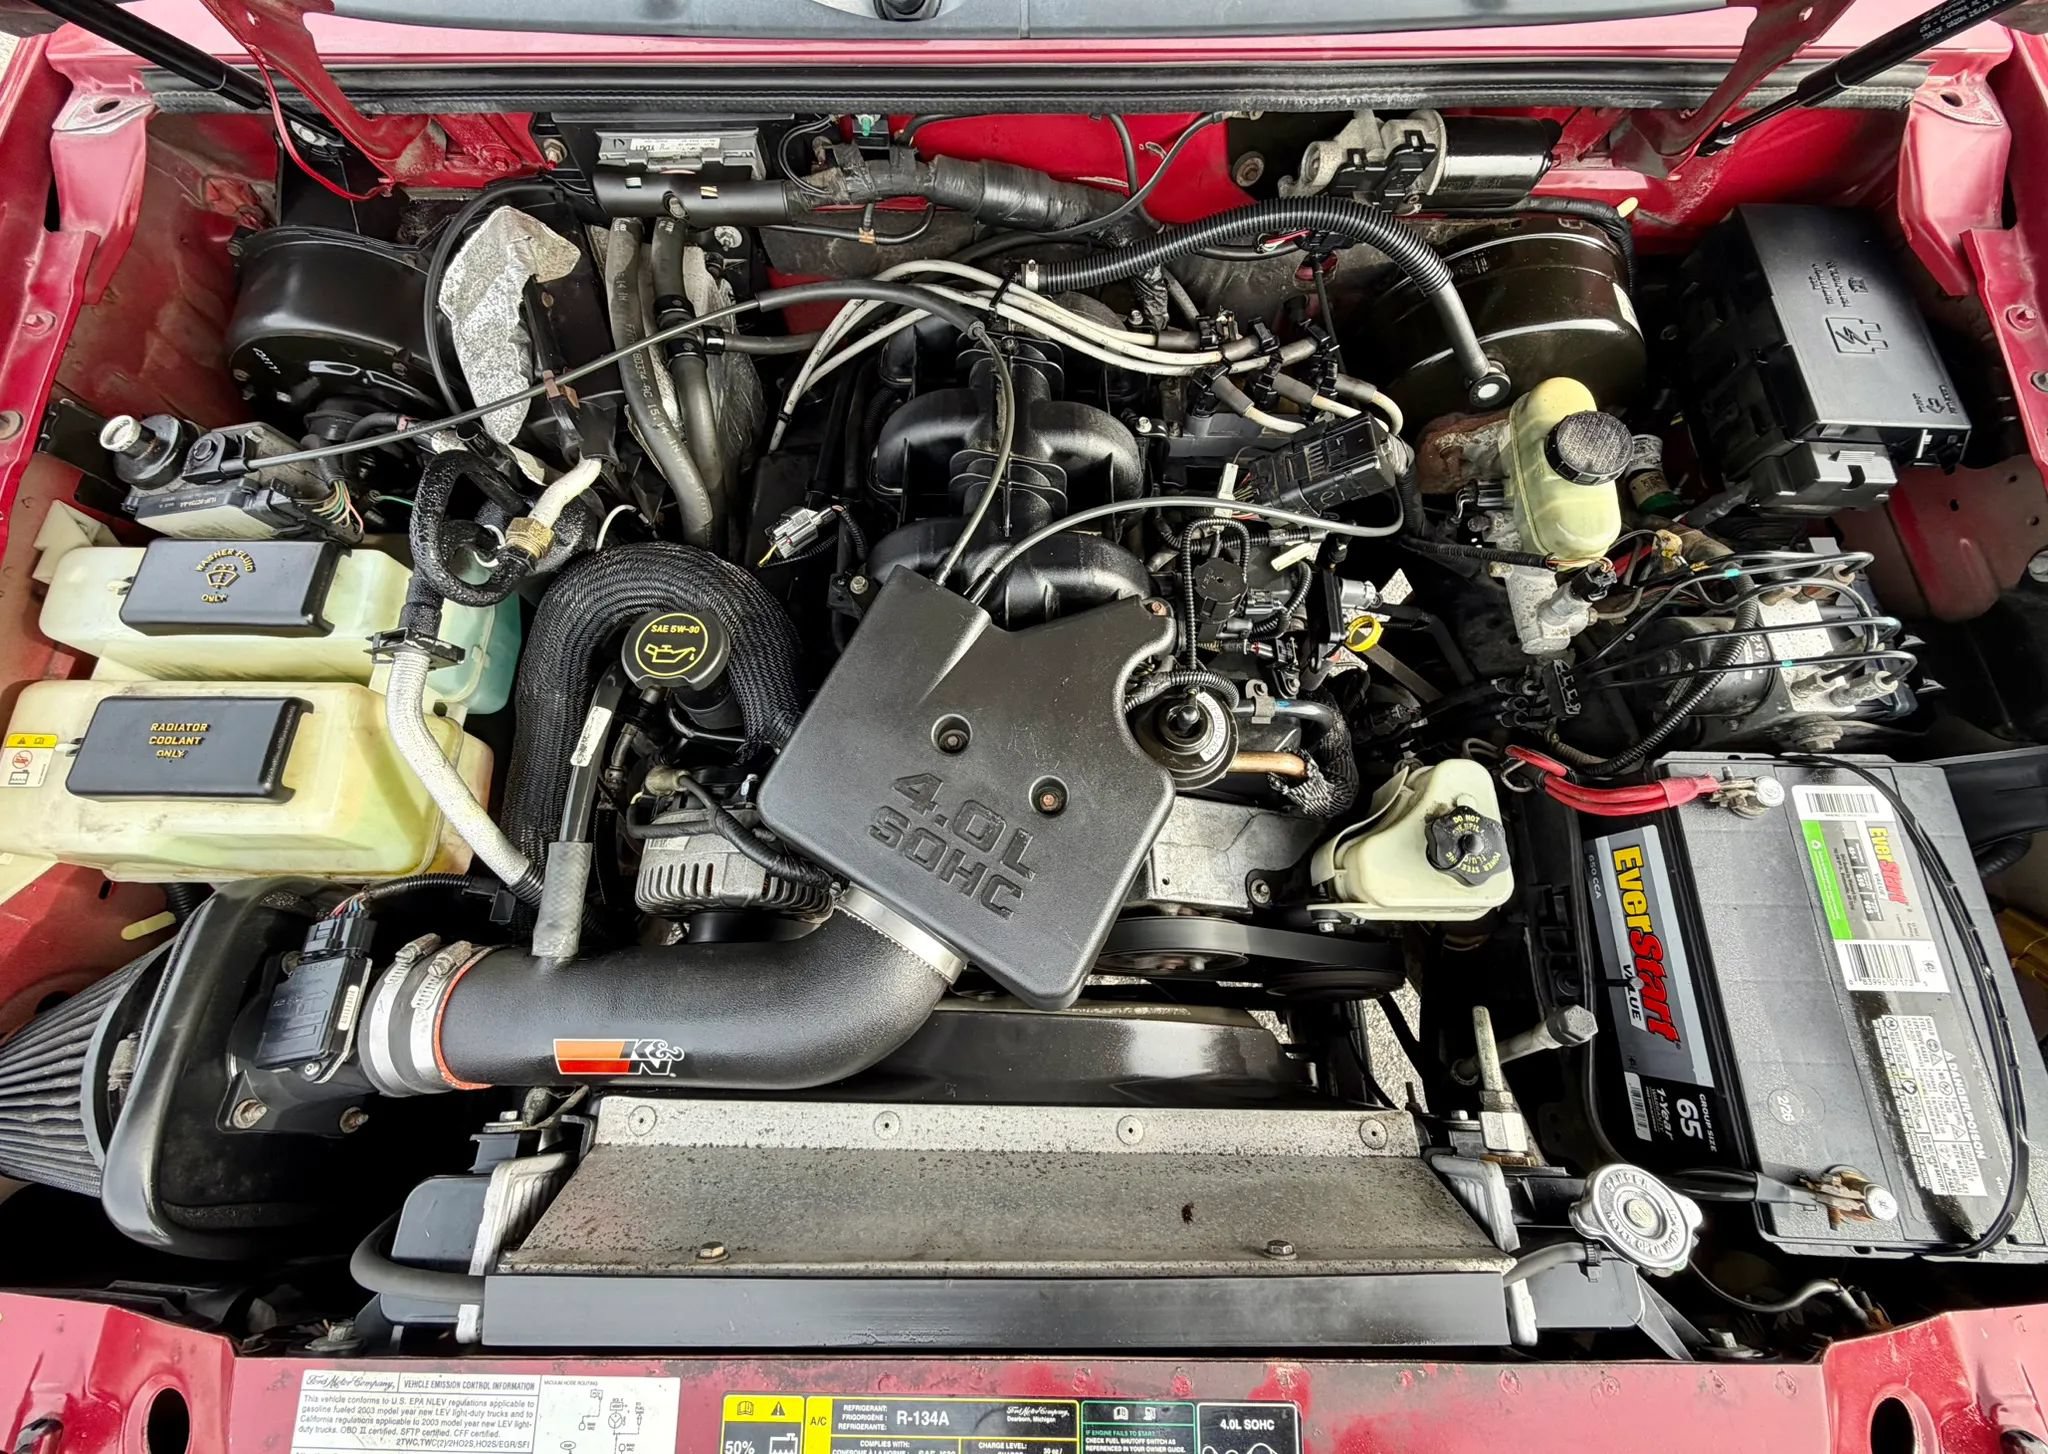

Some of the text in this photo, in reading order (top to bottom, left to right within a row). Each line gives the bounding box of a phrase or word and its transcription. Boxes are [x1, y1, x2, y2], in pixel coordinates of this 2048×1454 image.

[196, 548, 254, 573] WASHER FLUID
[201, 593, 227, 602] ONLY
[651, 624, 700, 634] SAE 5W-30
[150, 722, 208, 732] RADIATOR
[148, 736, 202, 745] COOLANT
[156, 750, 186, 758] ONLY
[1452, 814, 1480, 824] DO NOT
[892, 773, 1036, 881] 4.0L
[868, 806, 1024, 920] SOHC
[1482, 852, 1502, 872] POWER
[1588, 854, 1602, 900] 650 CCA
[1612, 844, 1681, 1042] EverStart
[630, 1039, 685, 1076] K&N
[1656, 1088, 1674, 1140] 1-Year
[1948, 1062, 1987, 1159] DANGER/POISON
[1676, 1098, 1704, 1140] 65
[1700, 1093, 1718, 1152] GROUP SIZE
[306, 1375, 328, 1386] Ford
[404, 1380, 535, 1390] VEHICLE EMISSION CONTROL INFORMATION
[321, 1395, 345, 1403] vehicle
[348, 1396, 380, 1404] conforms
[426, 1398, 446, 1406] NLEV
[449, 1398, 487, 1407] regulations
[490, 1400, 525, 1408] applicable
[302, 1405, 331, 1413] gasoline
[334, 1405, 355, 1413] fueled
[357, 1406, 375, 1414] 2003
[400, 1408, 416, 1416] year
[436, 1408, 449, 1416] LEV
[452, 1409, 485, 1418] light-duty
[300, 1415, 333, 1423] California
[335, 1416, 374, 1424] regulations
[376, 1417, 411, 1426] applicable
[441, 1419, 462, 1427] model
[464, 1420, 480, 1428] year
[498, 1420, 513, 1428] LEV
[810, 1416, 827, 1426] A/C
[896, 1411, 950, 1426] R-134A
[1220, 1420, 1275, 1430] 4.0L SOHC
[298, 1426, 314, 1435] duty
[725, 1440, 756, 1454] 50%
